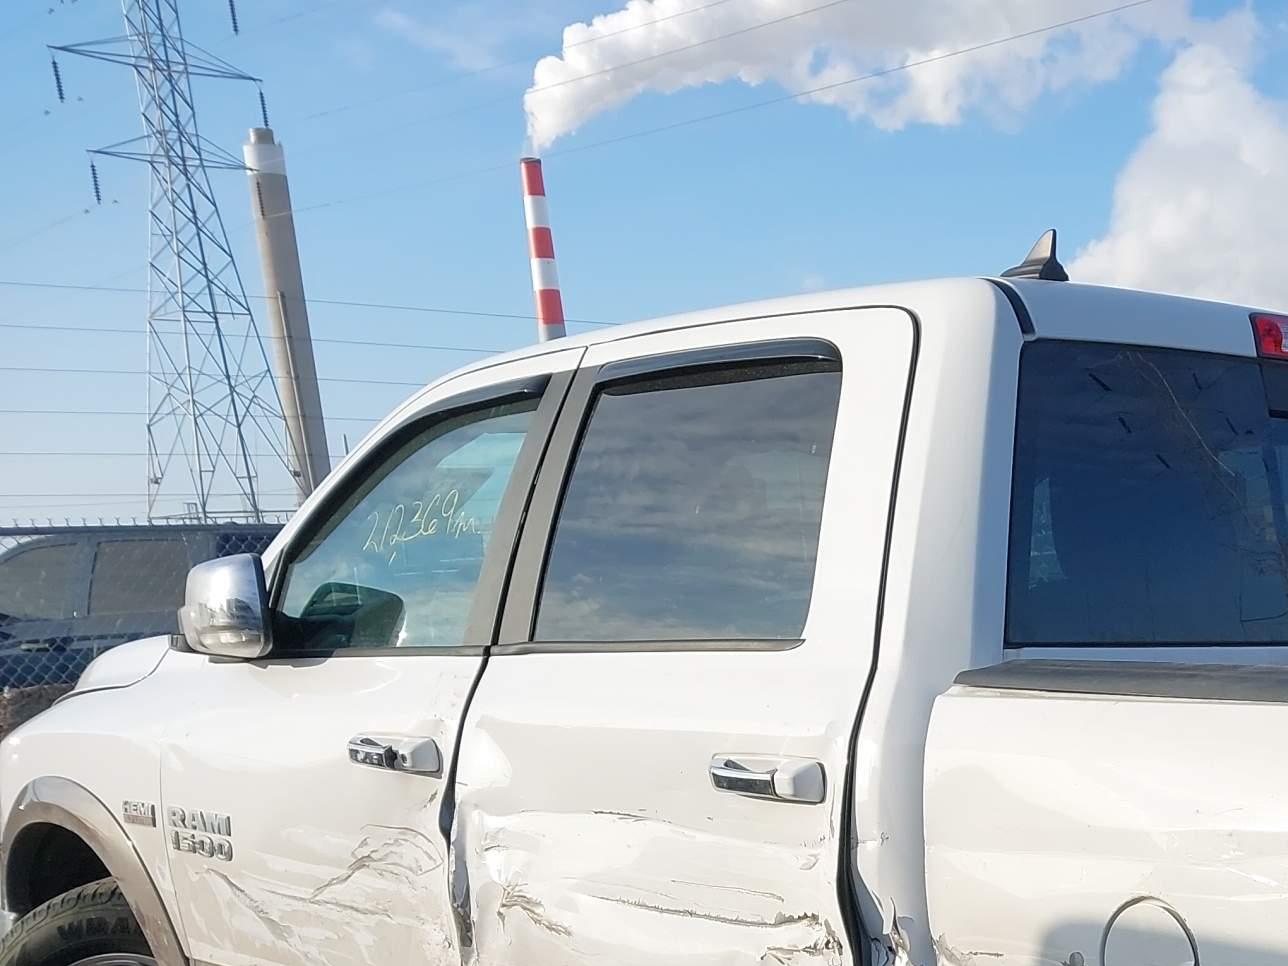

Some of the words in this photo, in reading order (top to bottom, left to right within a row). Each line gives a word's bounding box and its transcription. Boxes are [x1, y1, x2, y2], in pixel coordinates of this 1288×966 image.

[122, 800, 155, 819] HEMI
[167, 805, 231, 836] RAM
[171, 830, 233, 861] 1500
